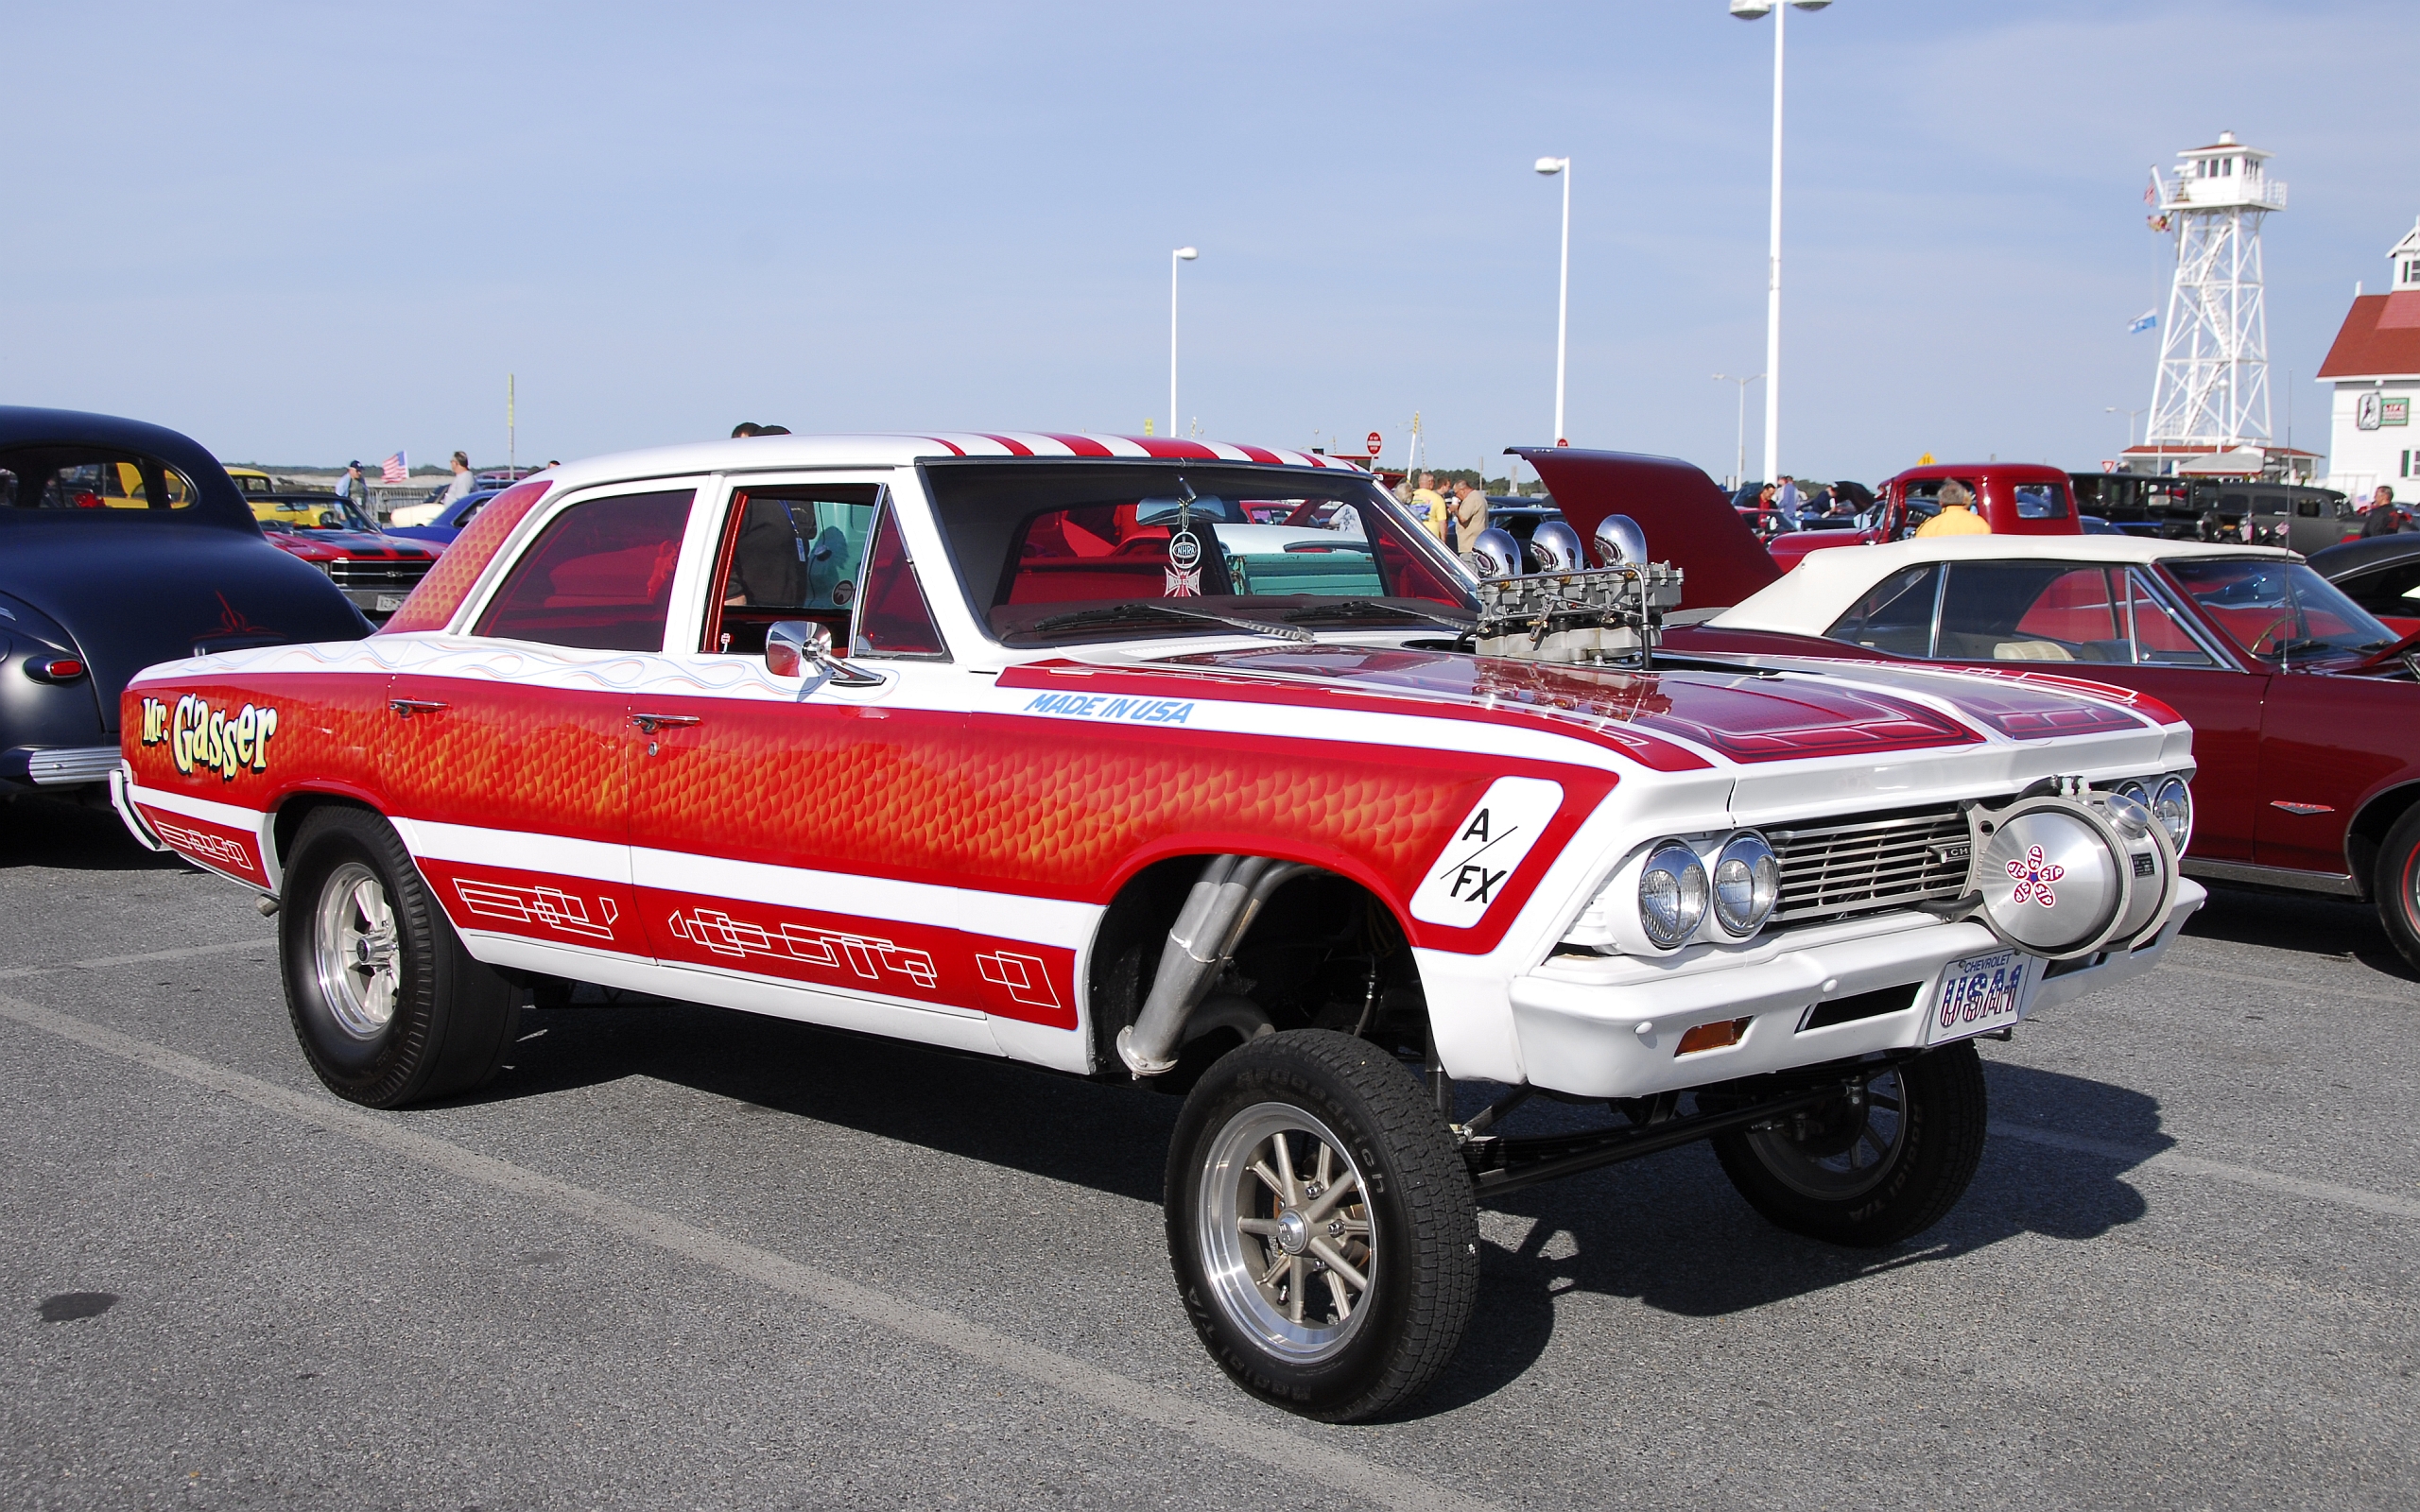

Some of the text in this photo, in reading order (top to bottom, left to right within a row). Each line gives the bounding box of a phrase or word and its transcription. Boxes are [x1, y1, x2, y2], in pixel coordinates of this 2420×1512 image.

[1177, 545, 1195, 556] NHRA
[1023, 693, 1195, 724] MADE IN USA
[142, 693, 278, 781] Mr. Gasser
[2028, 847, 2042, 869] STP
[2008, 862, 2027, 878] STP
[2042, 866, 2064, 881] STP
[1450, 865, 1507, 904] FX
[2014, 882, 2030, 902] STP
[2035, 885, 2052, 904] STP
[1963, 954, 2012, 973] CHEVROLET
